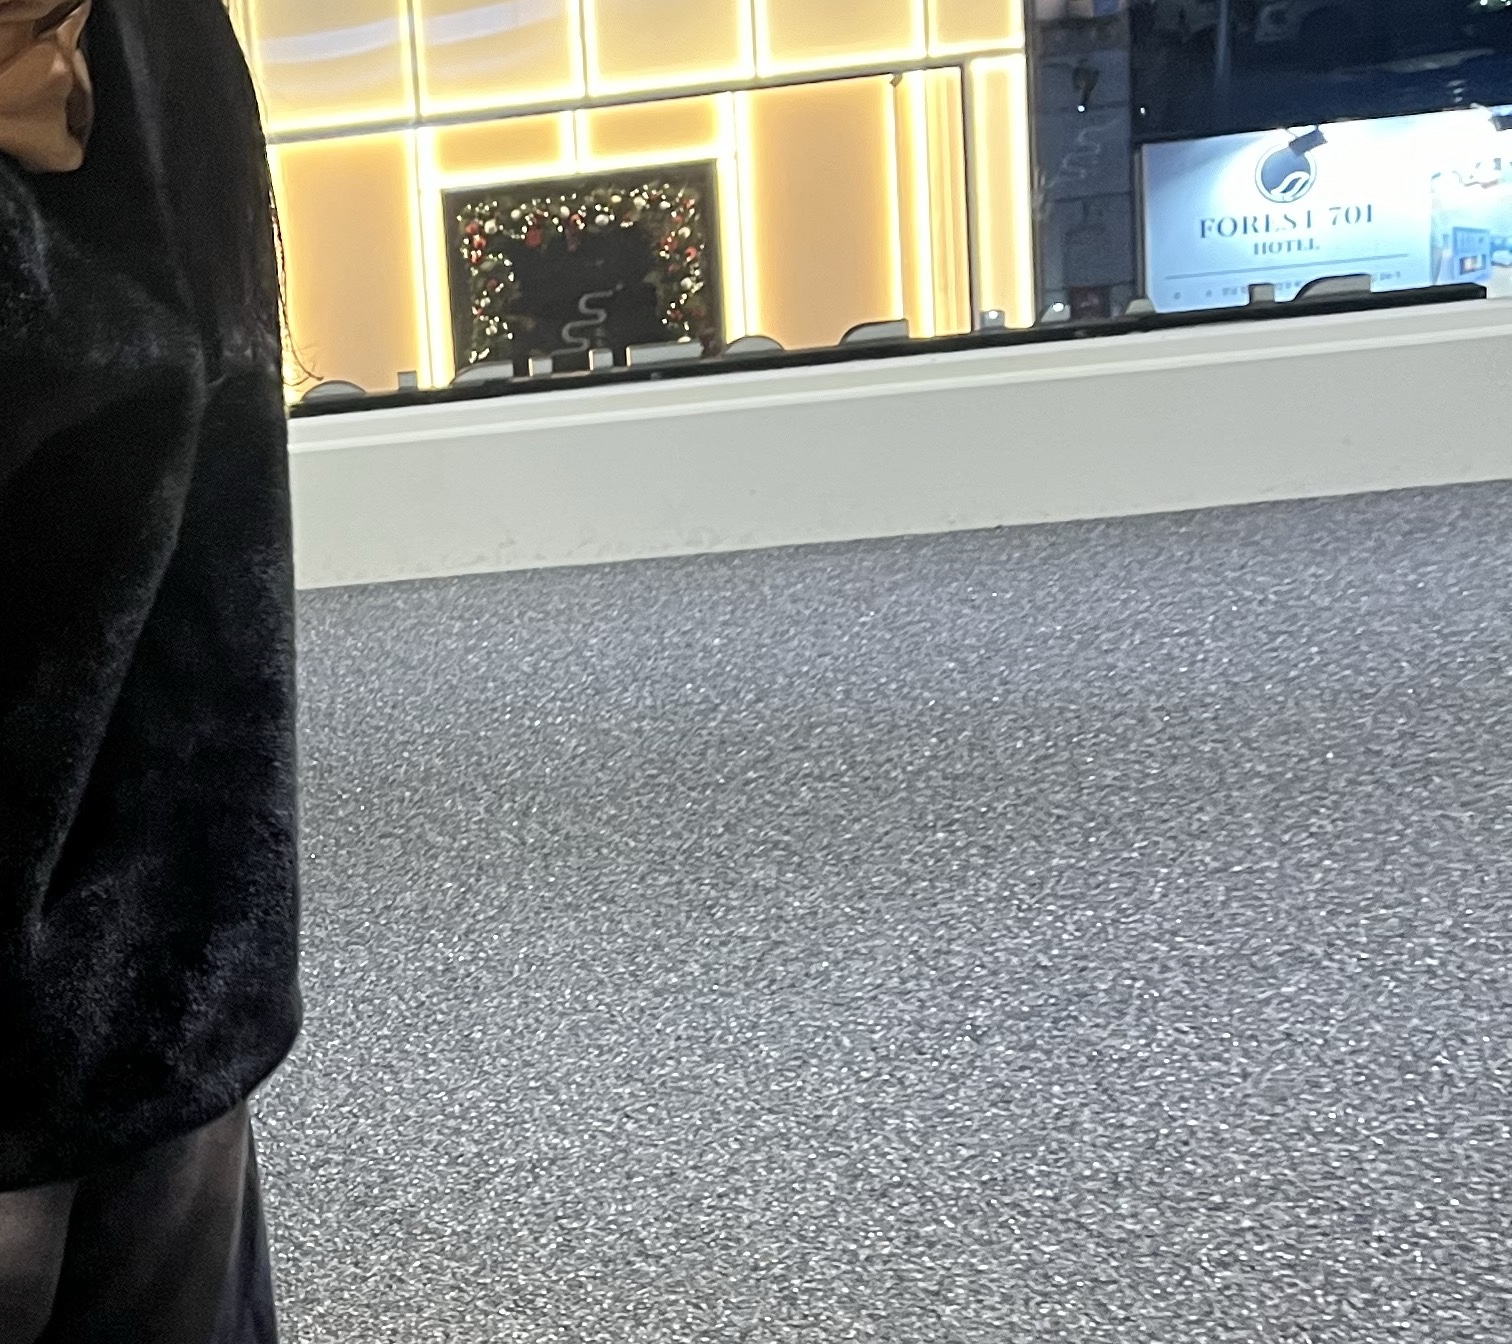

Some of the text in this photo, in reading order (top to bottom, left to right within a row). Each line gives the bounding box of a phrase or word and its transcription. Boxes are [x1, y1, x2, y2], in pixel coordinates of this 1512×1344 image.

[1199, 204, 1373, 239] FOREST 701
[1253, 238, 1321, 256] HOTEL
